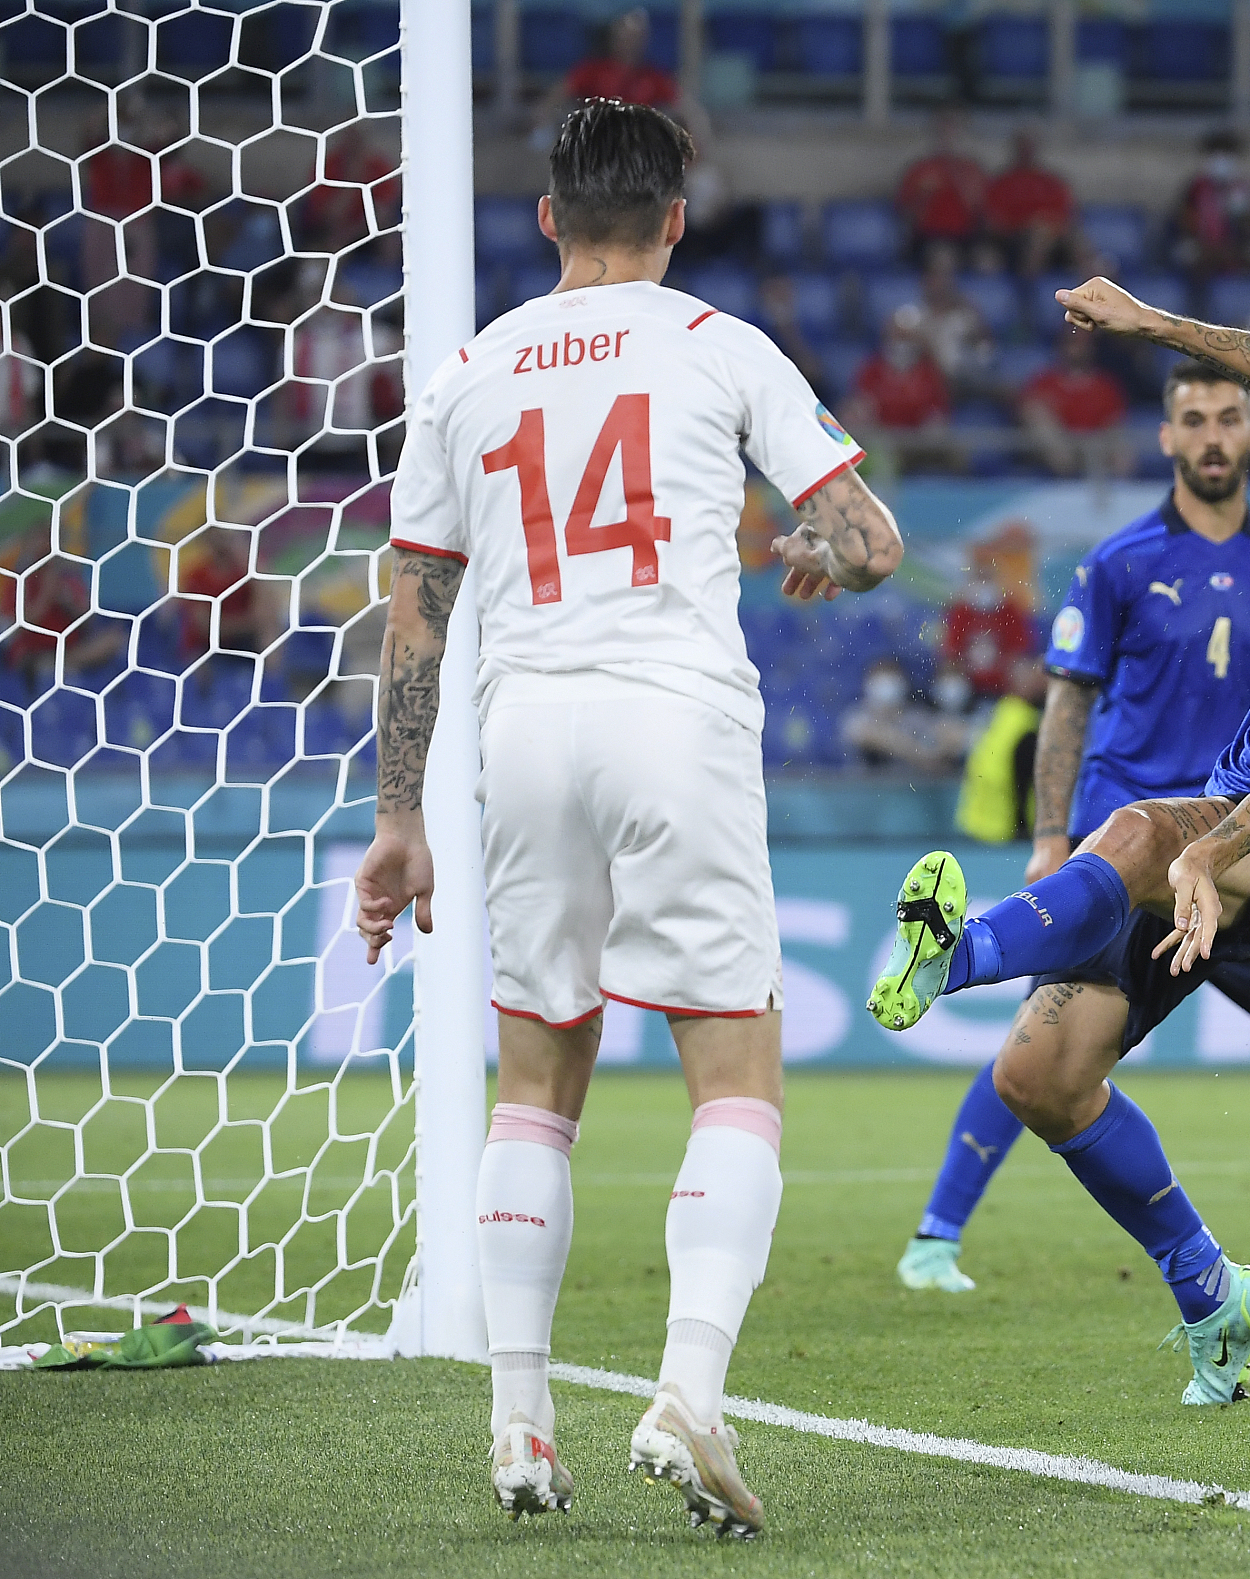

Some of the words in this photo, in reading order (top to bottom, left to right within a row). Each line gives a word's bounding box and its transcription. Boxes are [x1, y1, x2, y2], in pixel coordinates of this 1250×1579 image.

[513, 329, 630, 375] zuber
[481, 392, 672, 606] 14
[1206, 616, 1231, 679] 4
[1003, 891, 1053, 927] TALIA
[478, 1209, 546, 1227] suisse
